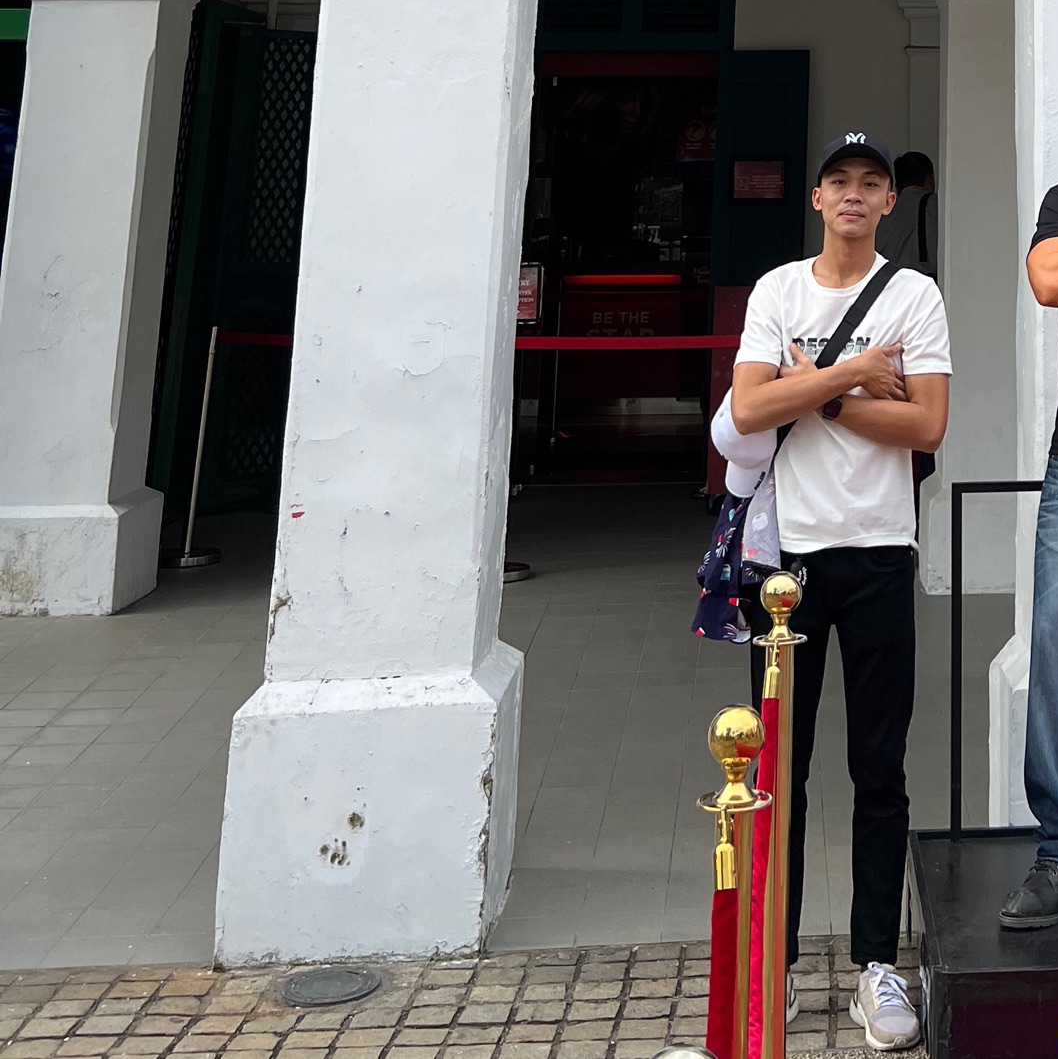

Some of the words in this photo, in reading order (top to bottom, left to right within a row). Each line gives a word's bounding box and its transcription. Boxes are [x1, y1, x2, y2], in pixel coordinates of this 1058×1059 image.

[592, 311, 613, 324] BE
[618, 311, 650, 324] THE
[792, 336, 871, 356] DESGN
